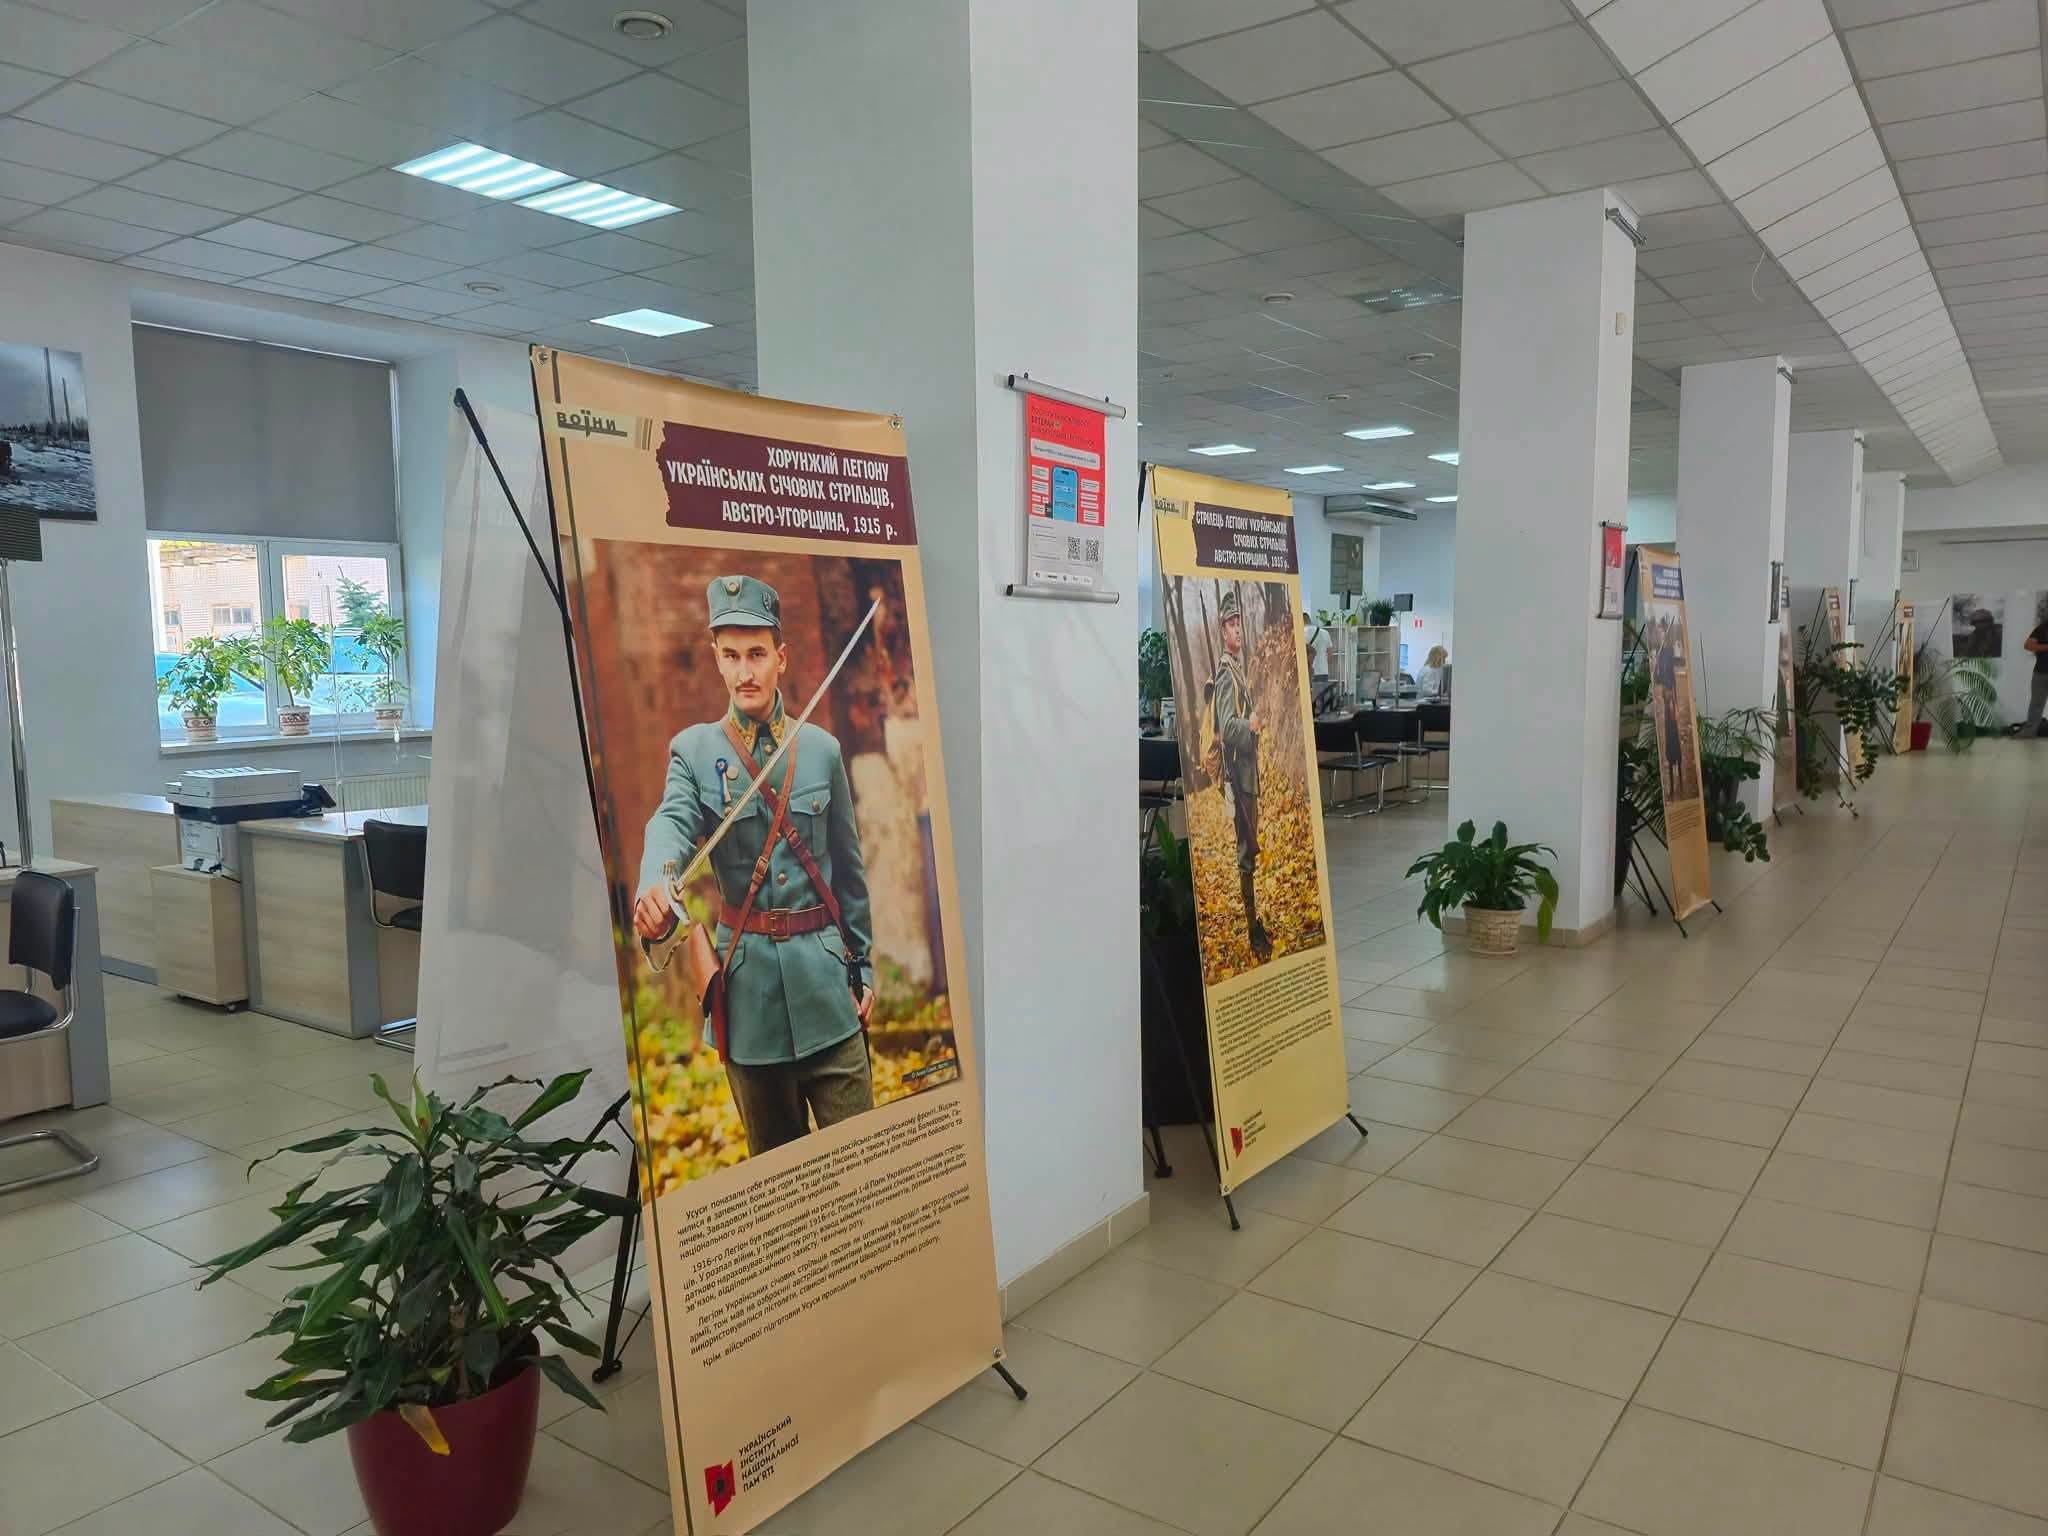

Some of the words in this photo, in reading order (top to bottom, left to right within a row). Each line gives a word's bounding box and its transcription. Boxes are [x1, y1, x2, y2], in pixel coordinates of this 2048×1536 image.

[666, 460, 766, 494] УКРАЇНСЬКИХ
[770, 475, 825, 499] СІЧОВИХ
[829, 484, 894, 509] СТРІЛЬЦІВ,
[767, 446, 838, 475] ХОРУНЖИЙ
[842, 455, 889, 481] ЛЕГІОНУ
[722, 501, 849, 533] АВСТРО-УГОРЩИНА,
[853, 516, 881, 534] 1915
[886, 523, 898, 540] р.
[677, 1218, 704, 1236] чилися
[714, 1200, 746, 1219] запеклих
[749, 1190, 765, 1203] боях
[777, 1179, 793, 1192] гори
[823, 1162, 830, 1170] та
[685, 1203, 707, 1221] Усуси
[710, 1188, 745, 1209] показали
[746, 1179, 762, 1193] себе
[831, 1148, 839, 1156] на
[678, 1230, 704, 1249] личем,
[706, 1208, 747, 1235] Завадовом
[800, 1180, 809, 1191] Та
[810, 1177, 820, 1187] ще
[679, 1226, 735, 1260] національного
[737, 1219, 753, 1234] духу
[682, 1274, 697, 1291] ців.
[705, 1260, 732, 1281] розпал
[837, 1199, 853, 1213] Полк
[692, 1251, 722, 1273] 1916-го
[723, 1238, 748, 1258] Легіон
[749, 1232, 761, 1246] був
[762, 1209, 809, 1239] перетворений
[811, 1206, 819, 1214] на
[684, 1279, 716, 1302] датково
[730, 1307, 744, 1321] мав
[746, 1302, 754, 1312] на
[697, 1305, 723, 1327] Легіон
[702, 1350, 721, 1370] Крім
[801, 1294, 820, 1313] Усуси
[739, 1415, 792, 1456] УКРАЇНСЬКИЙ
[740, 1439, 777, 1469] ІНСТИТУТ
[741, 1433, 800, 1480] НАЦІОНАЛЬНОЇ
